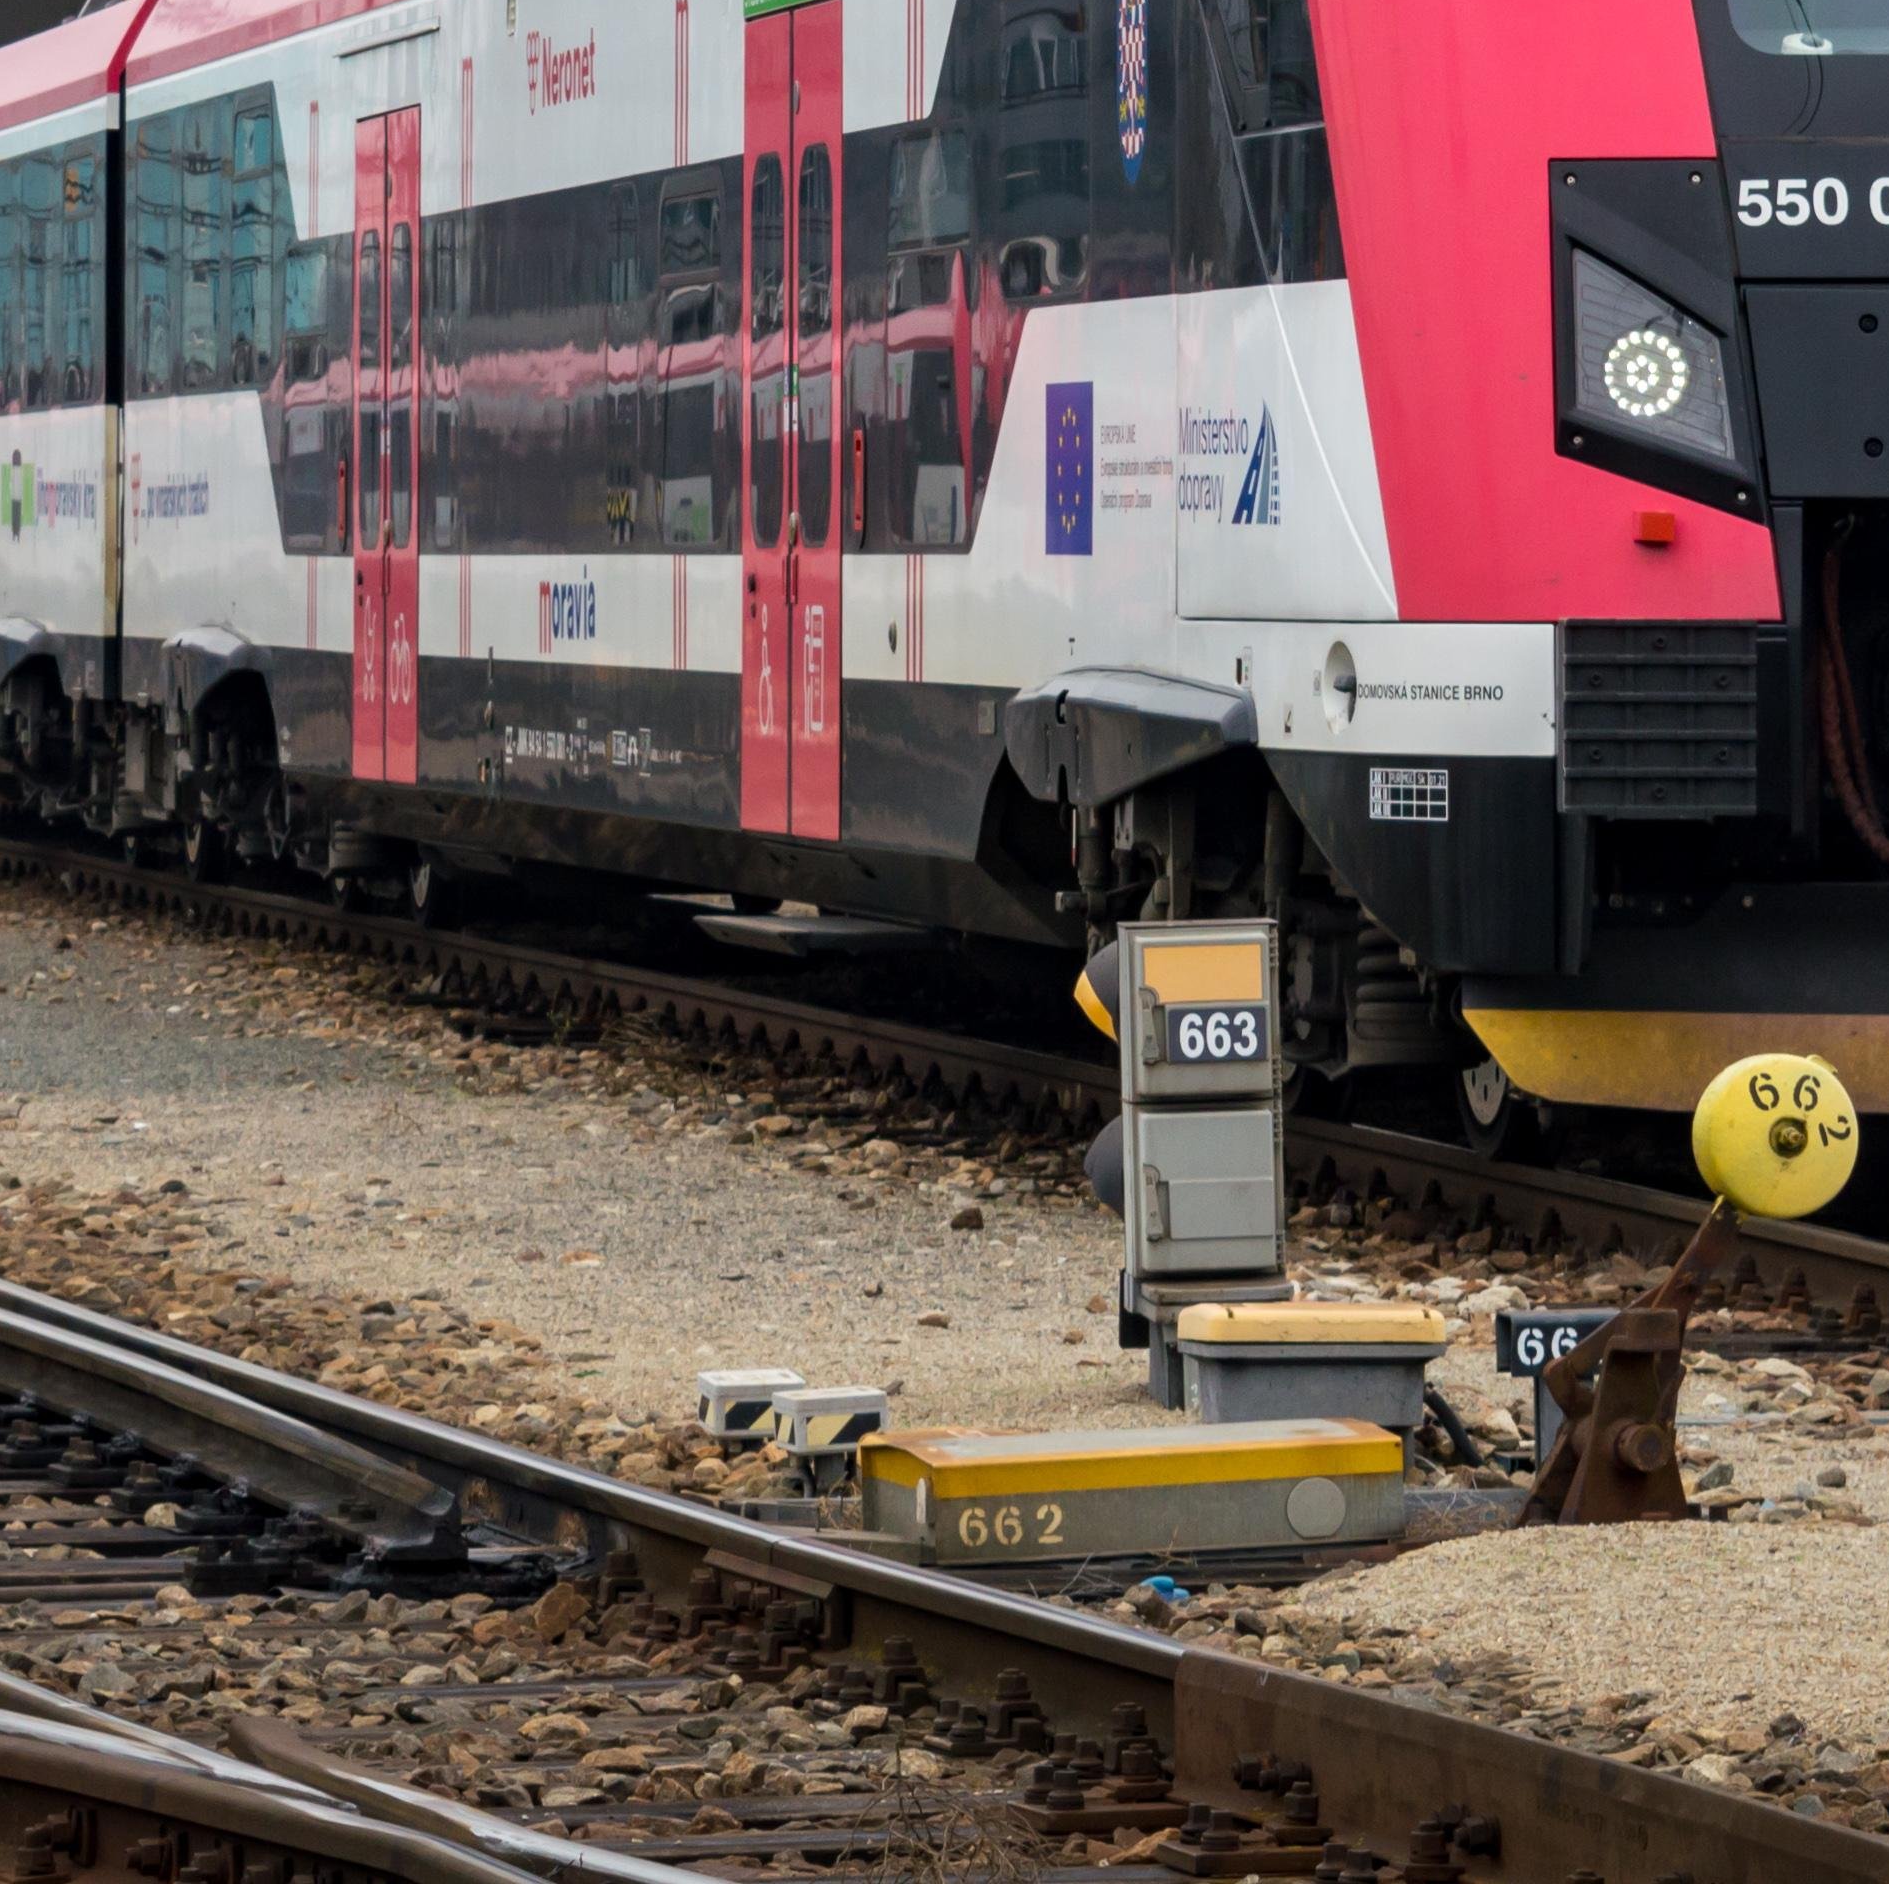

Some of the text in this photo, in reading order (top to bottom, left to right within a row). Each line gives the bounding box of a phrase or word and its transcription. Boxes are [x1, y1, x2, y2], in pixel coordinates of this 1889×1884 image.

[542, 27, 595, 108] Neronet
[1737, 177, 1849, 226] 550
[1179, 406, 1249, 455] Ministerstvo
[1178, 462, 1225, 524] dopravy
[539, 563, 596, 654] moravia
[1358, 680, 1503, 701] DOMOVSKÁ STANICE BRNO
[1179, 1011, 1258, 1059] 663
[1748, 1072, 1852, 1148] 662
[1516, 1326, 1579, 1366] 66
[958, 1503, 1064, 1547] 662
